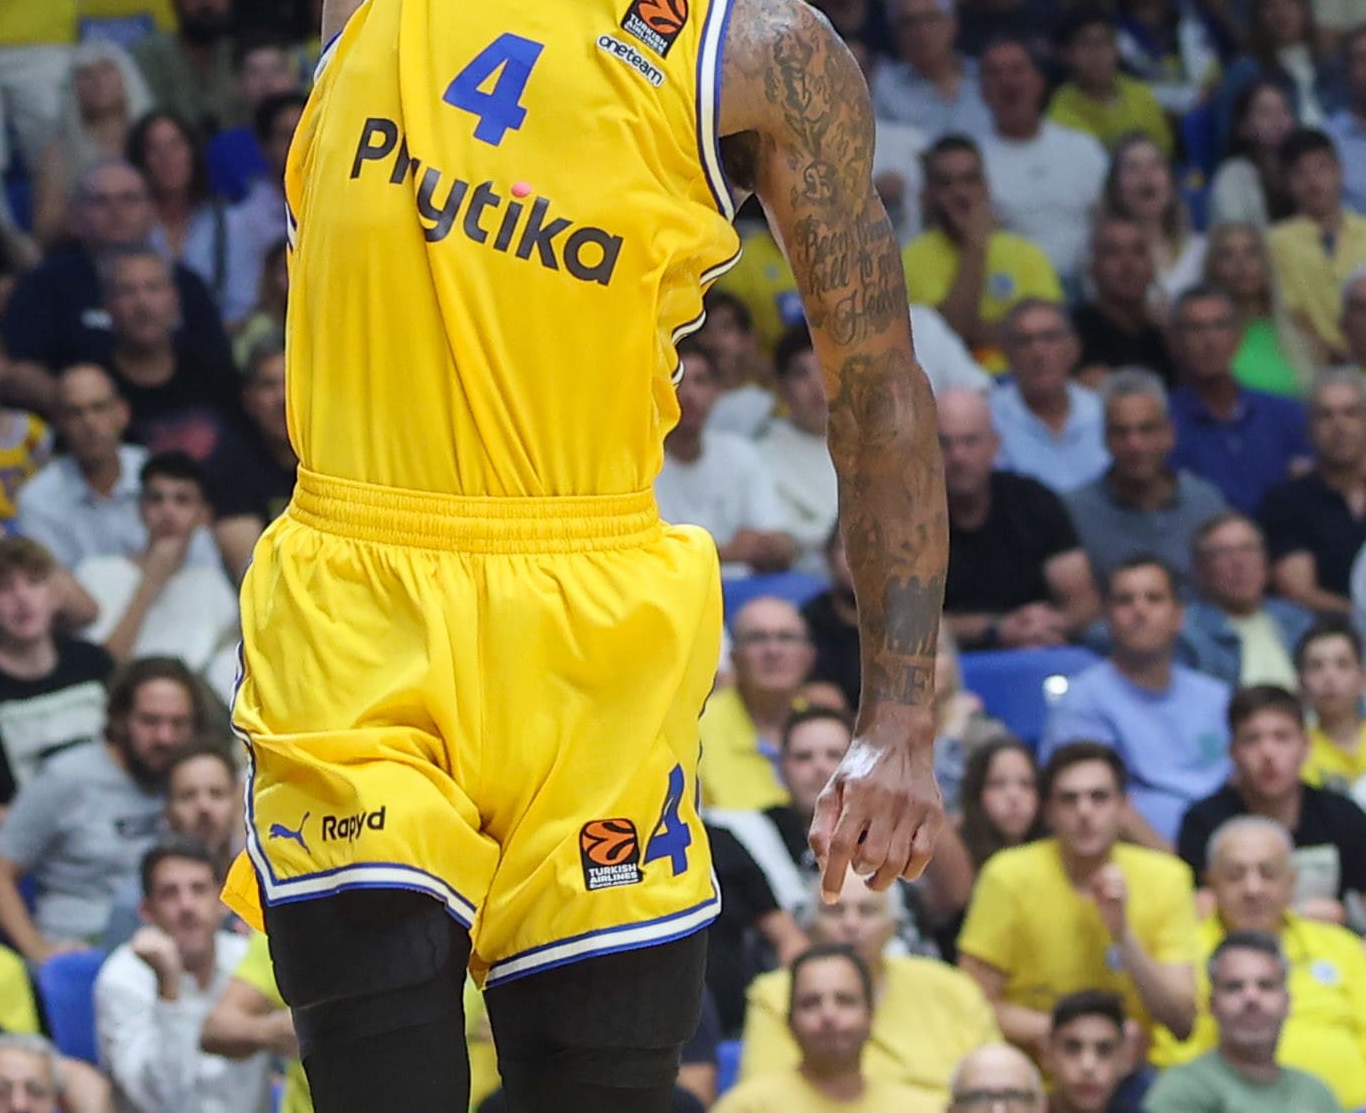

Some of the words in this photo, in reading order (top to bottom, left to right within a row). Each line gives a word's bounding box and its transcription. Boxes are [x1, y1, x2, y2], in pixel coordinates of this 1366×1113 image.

[599, 35, 663, 85] oneteam
[443, 33, 544, 146] 4
[350, 117, 624, 286] Plytika
[322, 805, 386, 843] Rapyd
[643, 762, 692, 877] 4
[588, 862, 637, 877] TURKISH
[590, 871, 639, 884] AIRLINES
